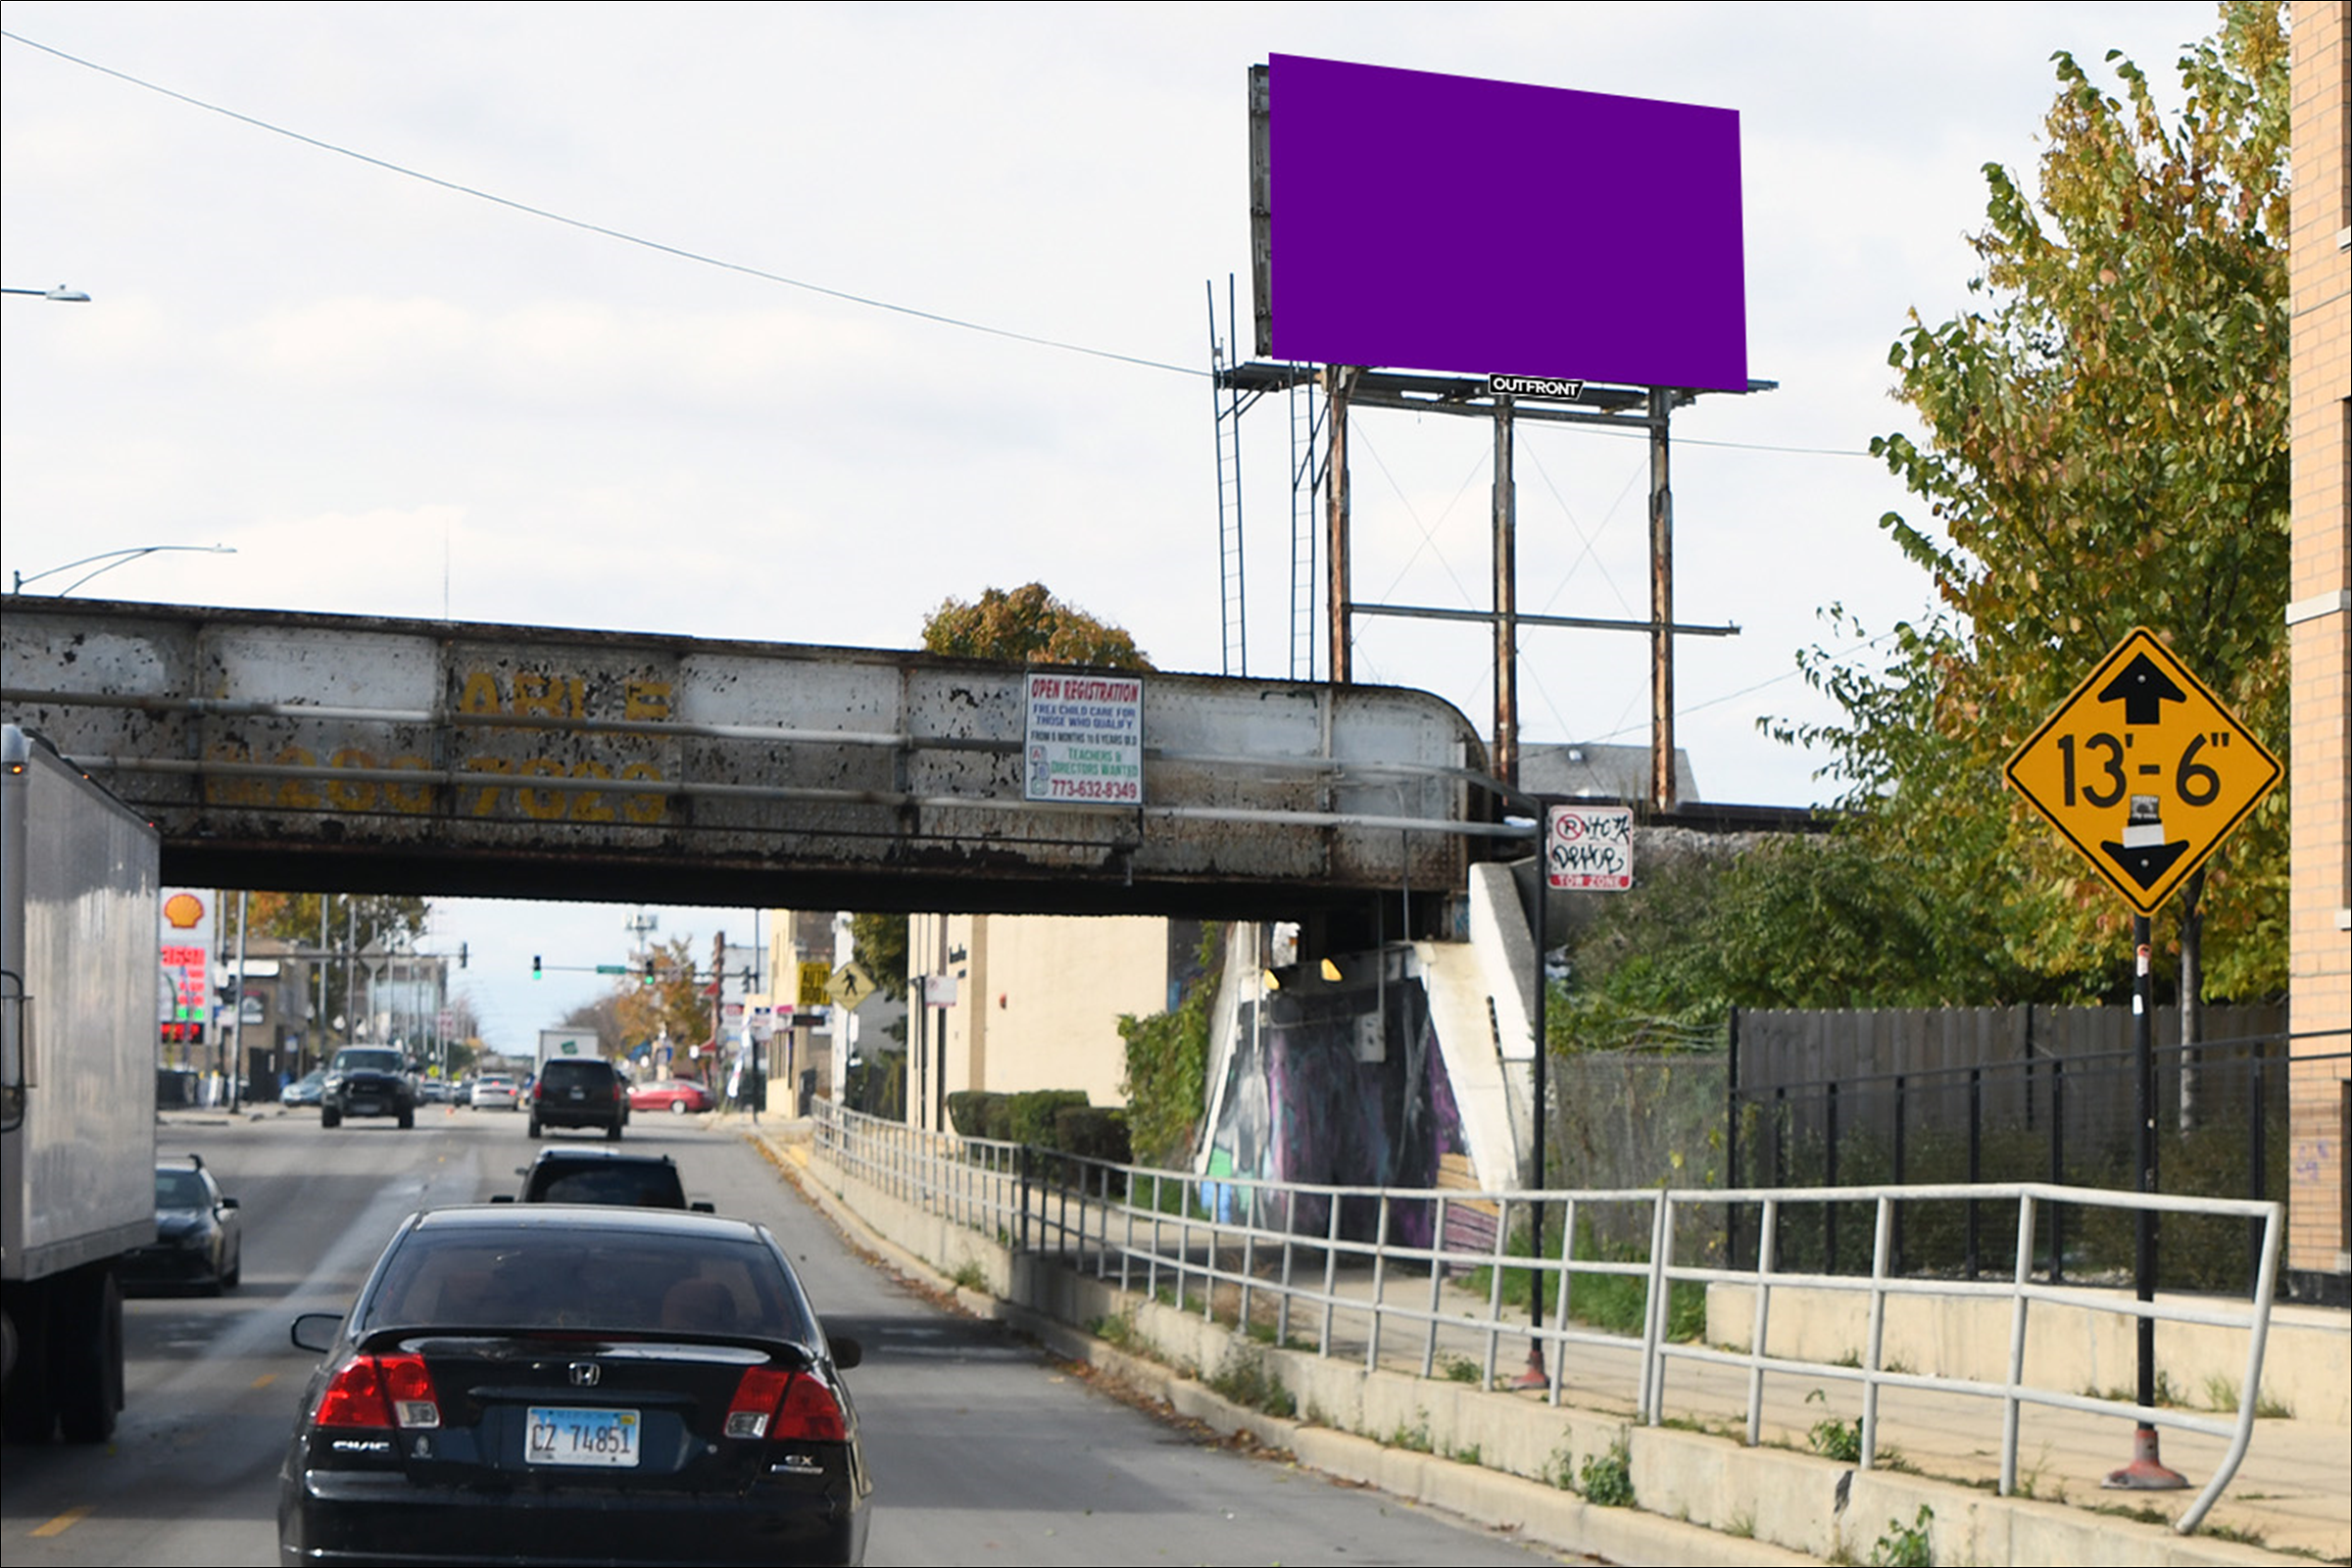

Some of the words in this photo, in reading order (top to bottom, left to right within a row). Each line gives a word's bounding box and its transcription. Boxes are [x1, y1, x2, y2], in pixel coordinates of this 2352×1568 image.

[1493, 377, 1579, 396] OUTFRONT
[1031, 678, 1060, 699] OPEN
[1064, 680, 1139, 703] REGISTRATION
[1033, 704, 1056, 715] FREE
[1059, 705, 1088, 716] CHILD
[1090, 707, 1113, 717] CARE
[1116, 708, 1136, 717] FOR
[1036, 715, 1065, 726] THOSE
[1069, 717, 1091, 728] WHO
[1093, 718, 1133, 729] QUALIFY
[1031, 731, 1050, 741] FROM
[1058, 732, 1085, 743] MONTHS
[1101, 734, 1123, 745] YEARS
[1124, 735, 1137, 746] OLD
[1068, 748, 1113, 762] TEACHERS
[1051, 760, 1100, 776] DIRECTORS
[1101, 763, 1139, 778] WANTED
[1052, 779, 1137, 800] 773-632-8349
[1559, 875, 1583, 887] TOW
[1590, 875, 1619, 888] ZONE
[532, 1424, 557, 1451] CZ
[570, 1425, 630, 1453] 74851
